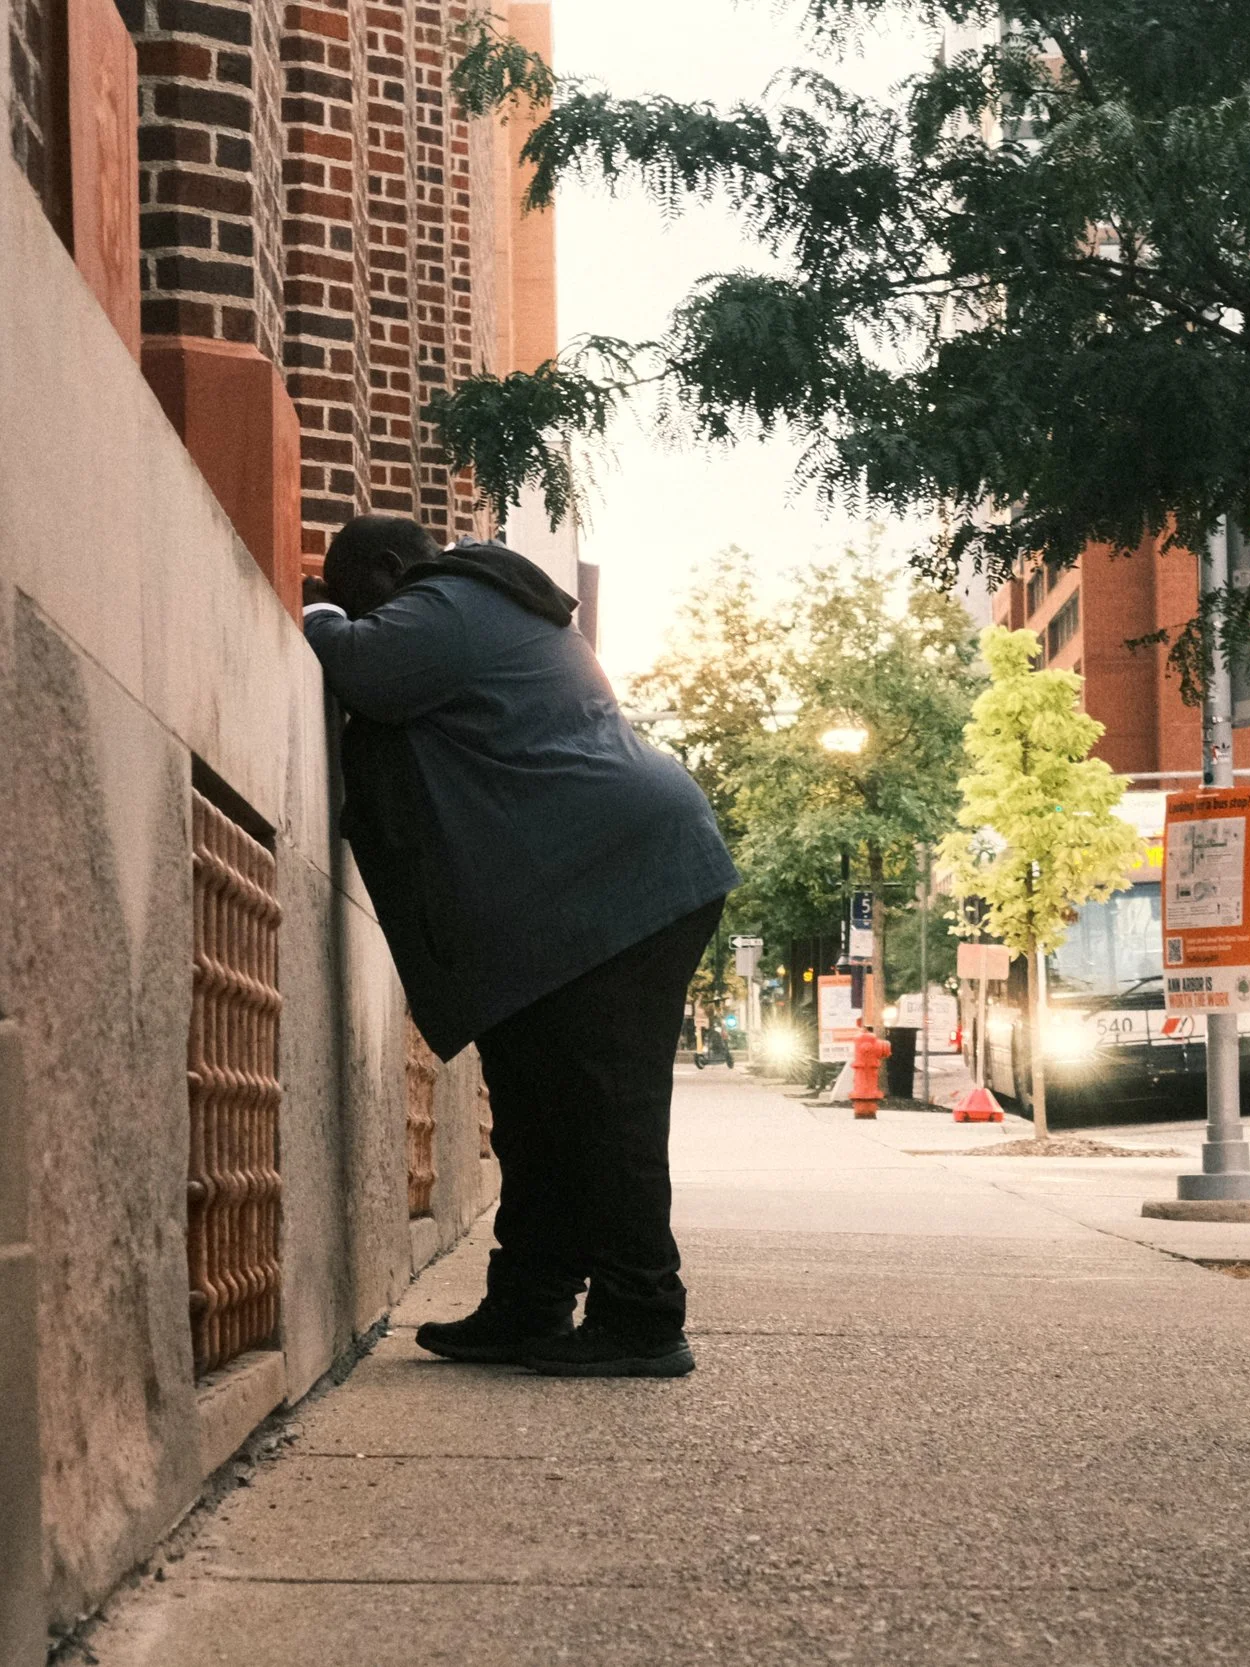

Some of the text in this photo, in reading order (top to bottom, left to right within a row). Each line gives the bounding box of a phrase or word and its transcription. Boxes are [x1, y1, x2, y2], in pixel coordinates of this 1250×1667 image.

[1213, 798, 1229, 810] bus
[861, 898, 871, 914] 5
[1167, 976, 1213, 992] ANN ARBOR IS
[1168, 992, 1193, 1009] WORTH
[1207, 991, 1230, 1007] WORK
[1097, 1017, 1132, 1035] 540
